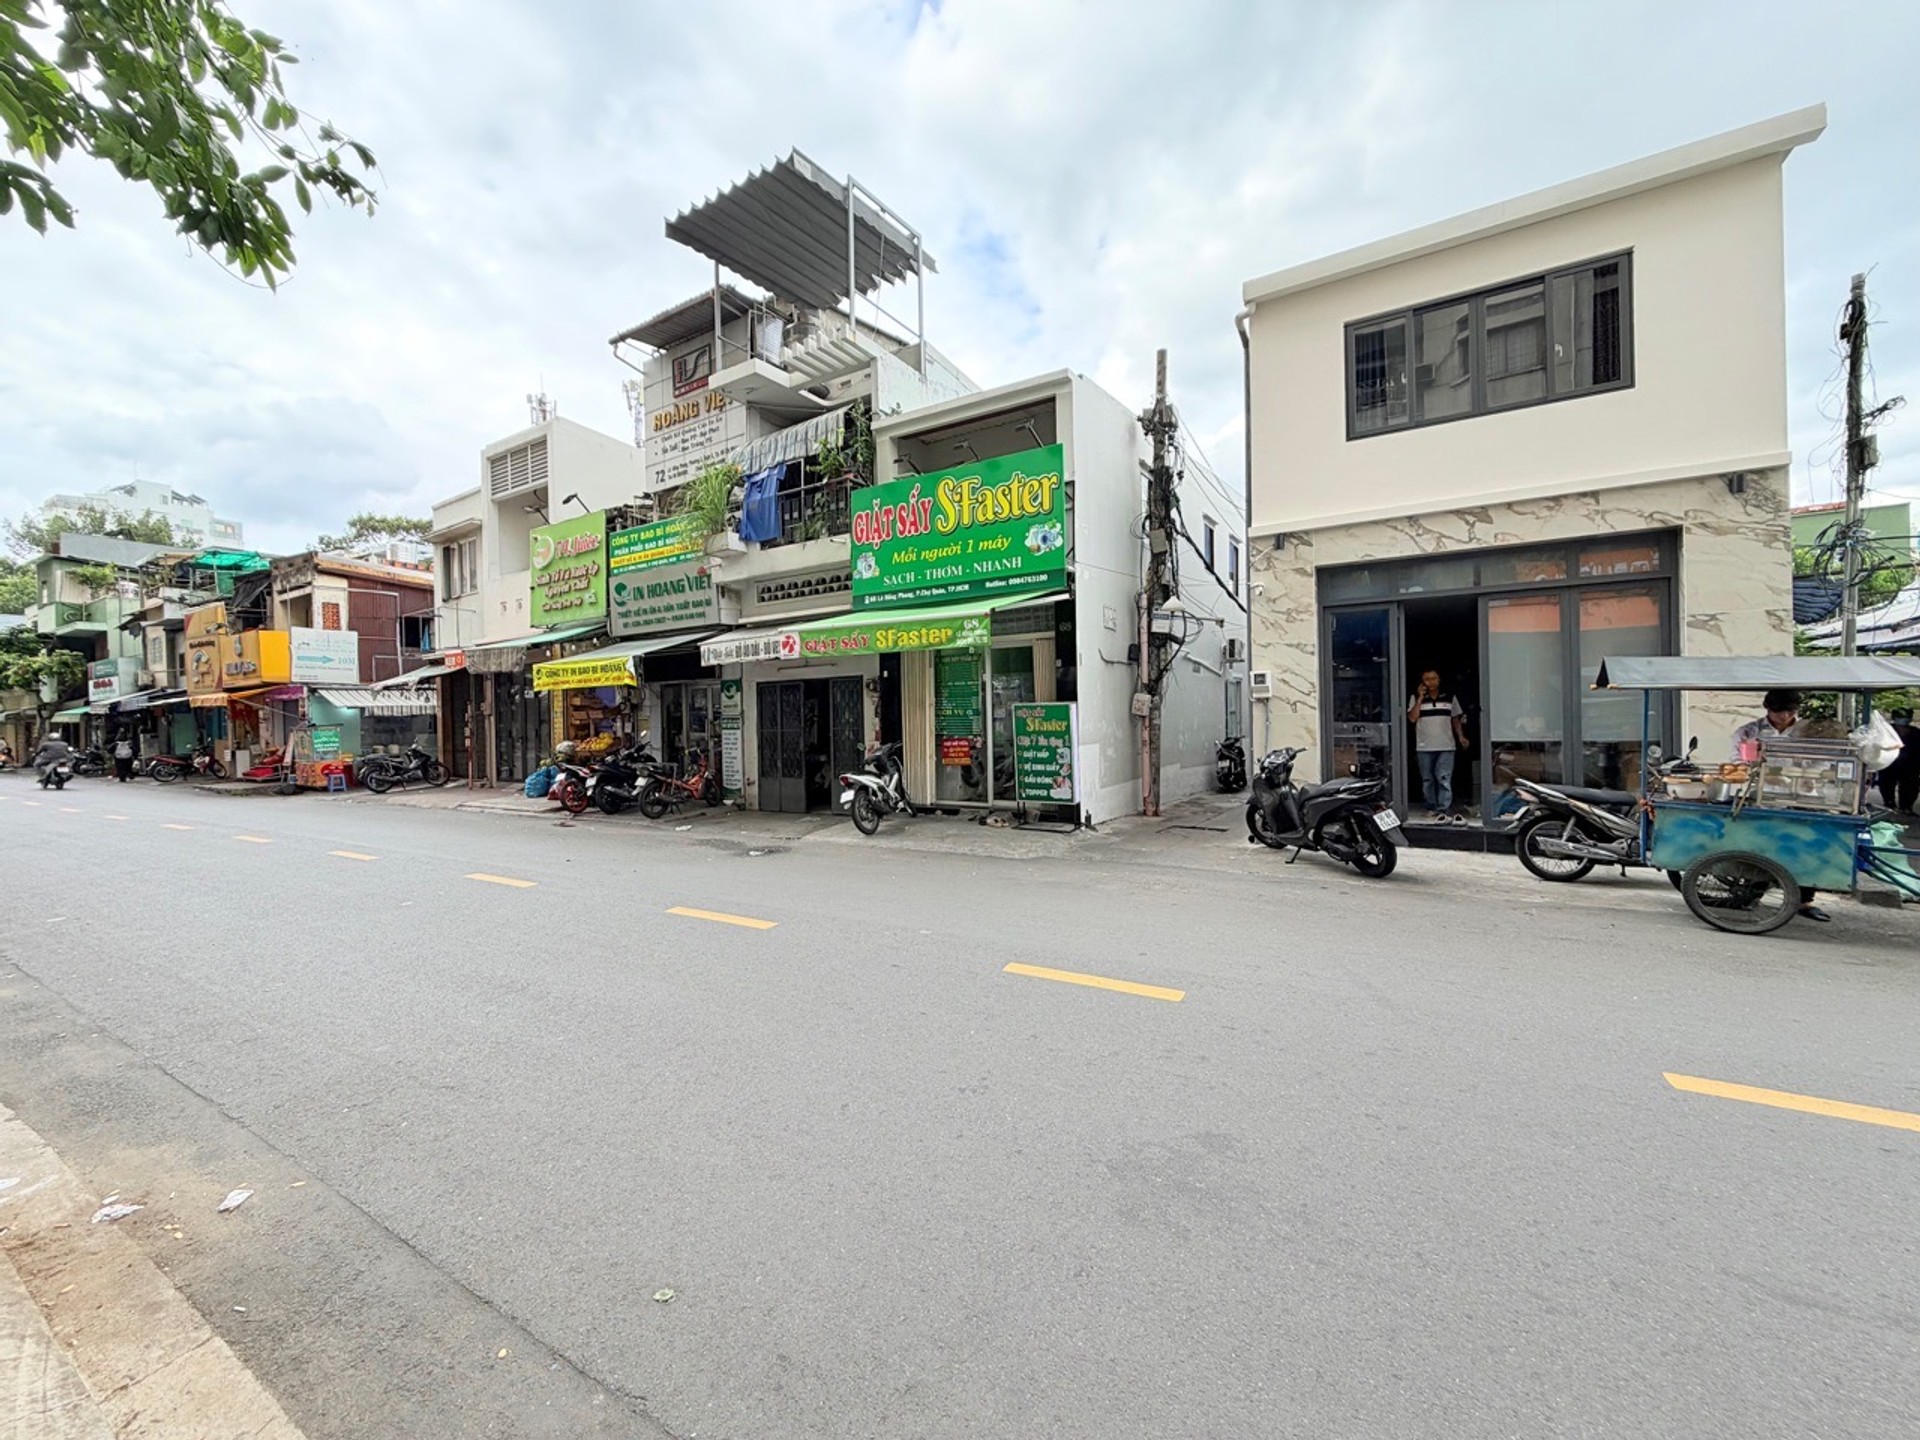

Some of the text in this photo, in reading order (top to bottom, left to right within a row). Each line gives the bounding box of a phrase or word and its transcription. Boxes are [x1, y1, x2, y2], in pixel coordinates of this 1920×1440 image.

[655, 469, 666, 484] 72
[853, 471, 1060, 550] GIẶT SẤY SFaster
[612, 535, 629, 546] CÔNG
[630, 533, 639, 542] TY
[641, 529, 655, 540] BAO
[656, 525, 664, 537] BÌ
[892, 533, 1013, 565] Mỗi người 1 máy
[883, 570, 915, 588] SẠCH
[924, 563, 963, 580] THƠM
[973, 556, 1022, 574] NHANH
[633, 586, 644, 601] IN
[804, 634, 837, 652] GIẶT
[840, 629, 870, 649] SẤY
[875, 627, 953, 649] SFaster
[578, 665, 590, 675] BAO
